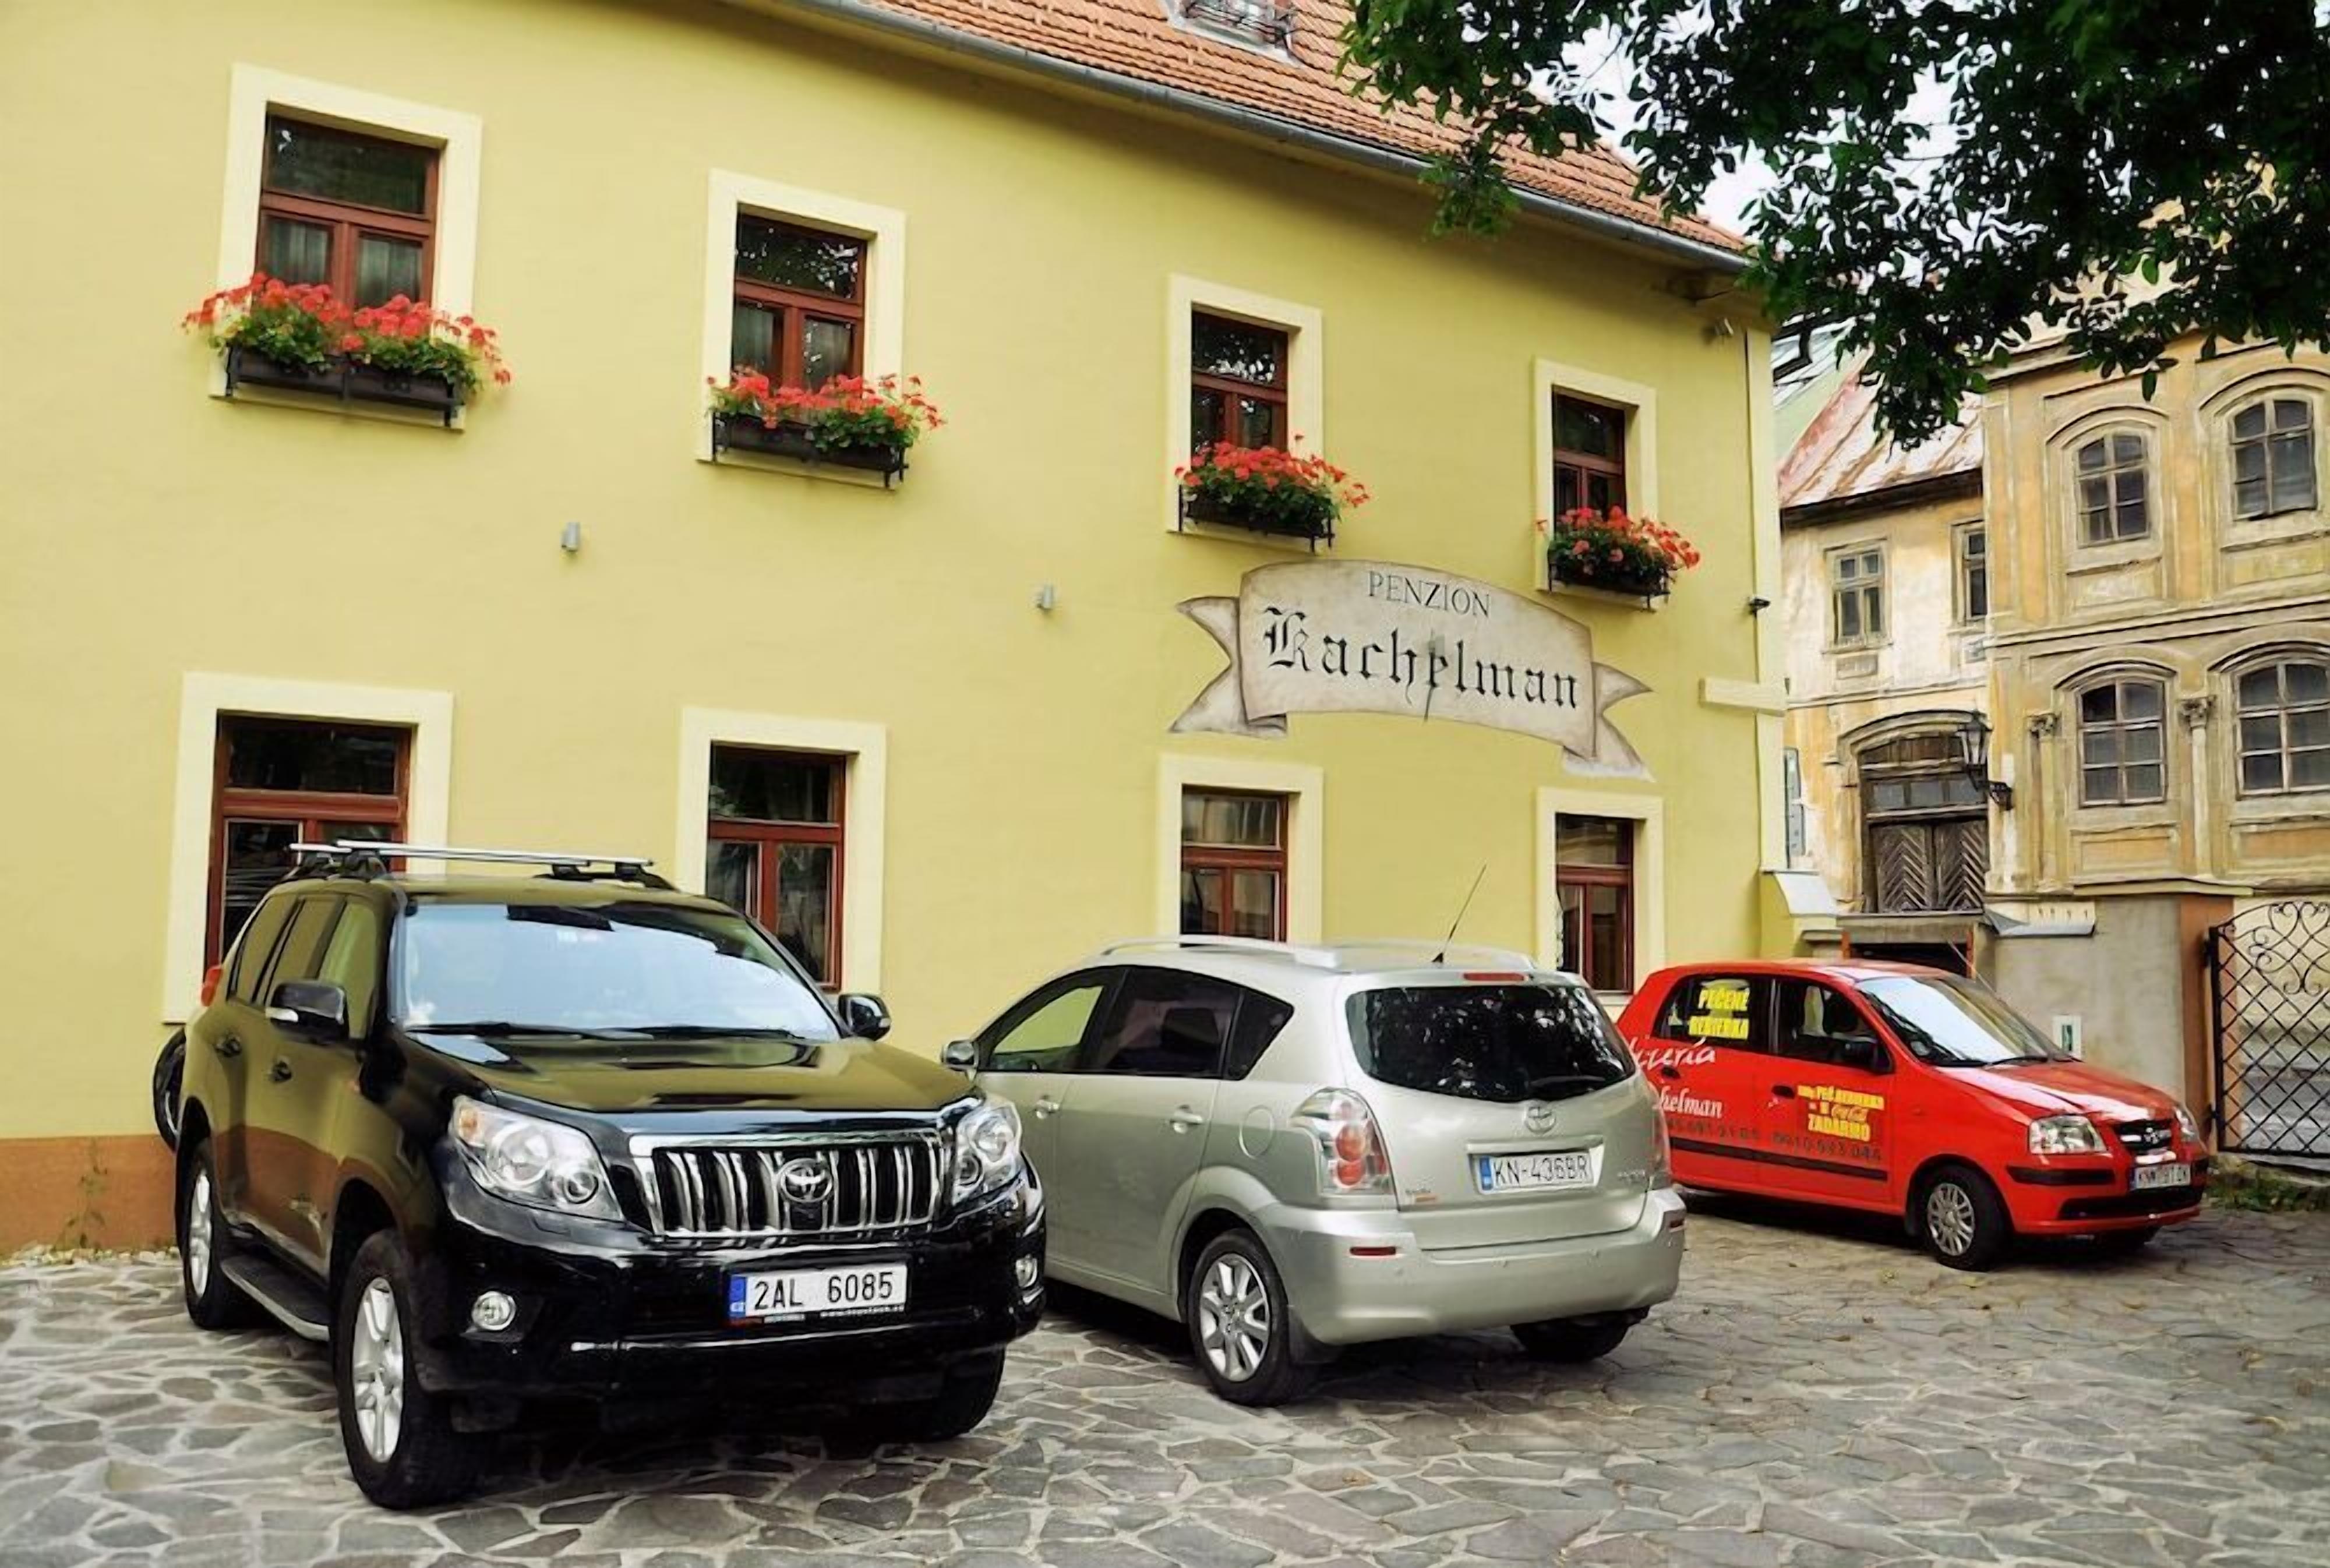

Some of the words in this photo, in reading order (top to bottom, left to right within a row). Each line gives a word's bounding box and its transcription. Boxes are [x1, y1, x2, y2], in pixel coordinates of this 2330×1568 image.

[1368, 570, 1491, 617] PENZION
[1263, 606, 1577, 709] Kachelman
[1658, 1085, 1723, 1119] helman
[754, 1278, 803, 1310] 2AL
[828, 1271, 892, 1303] 6085
